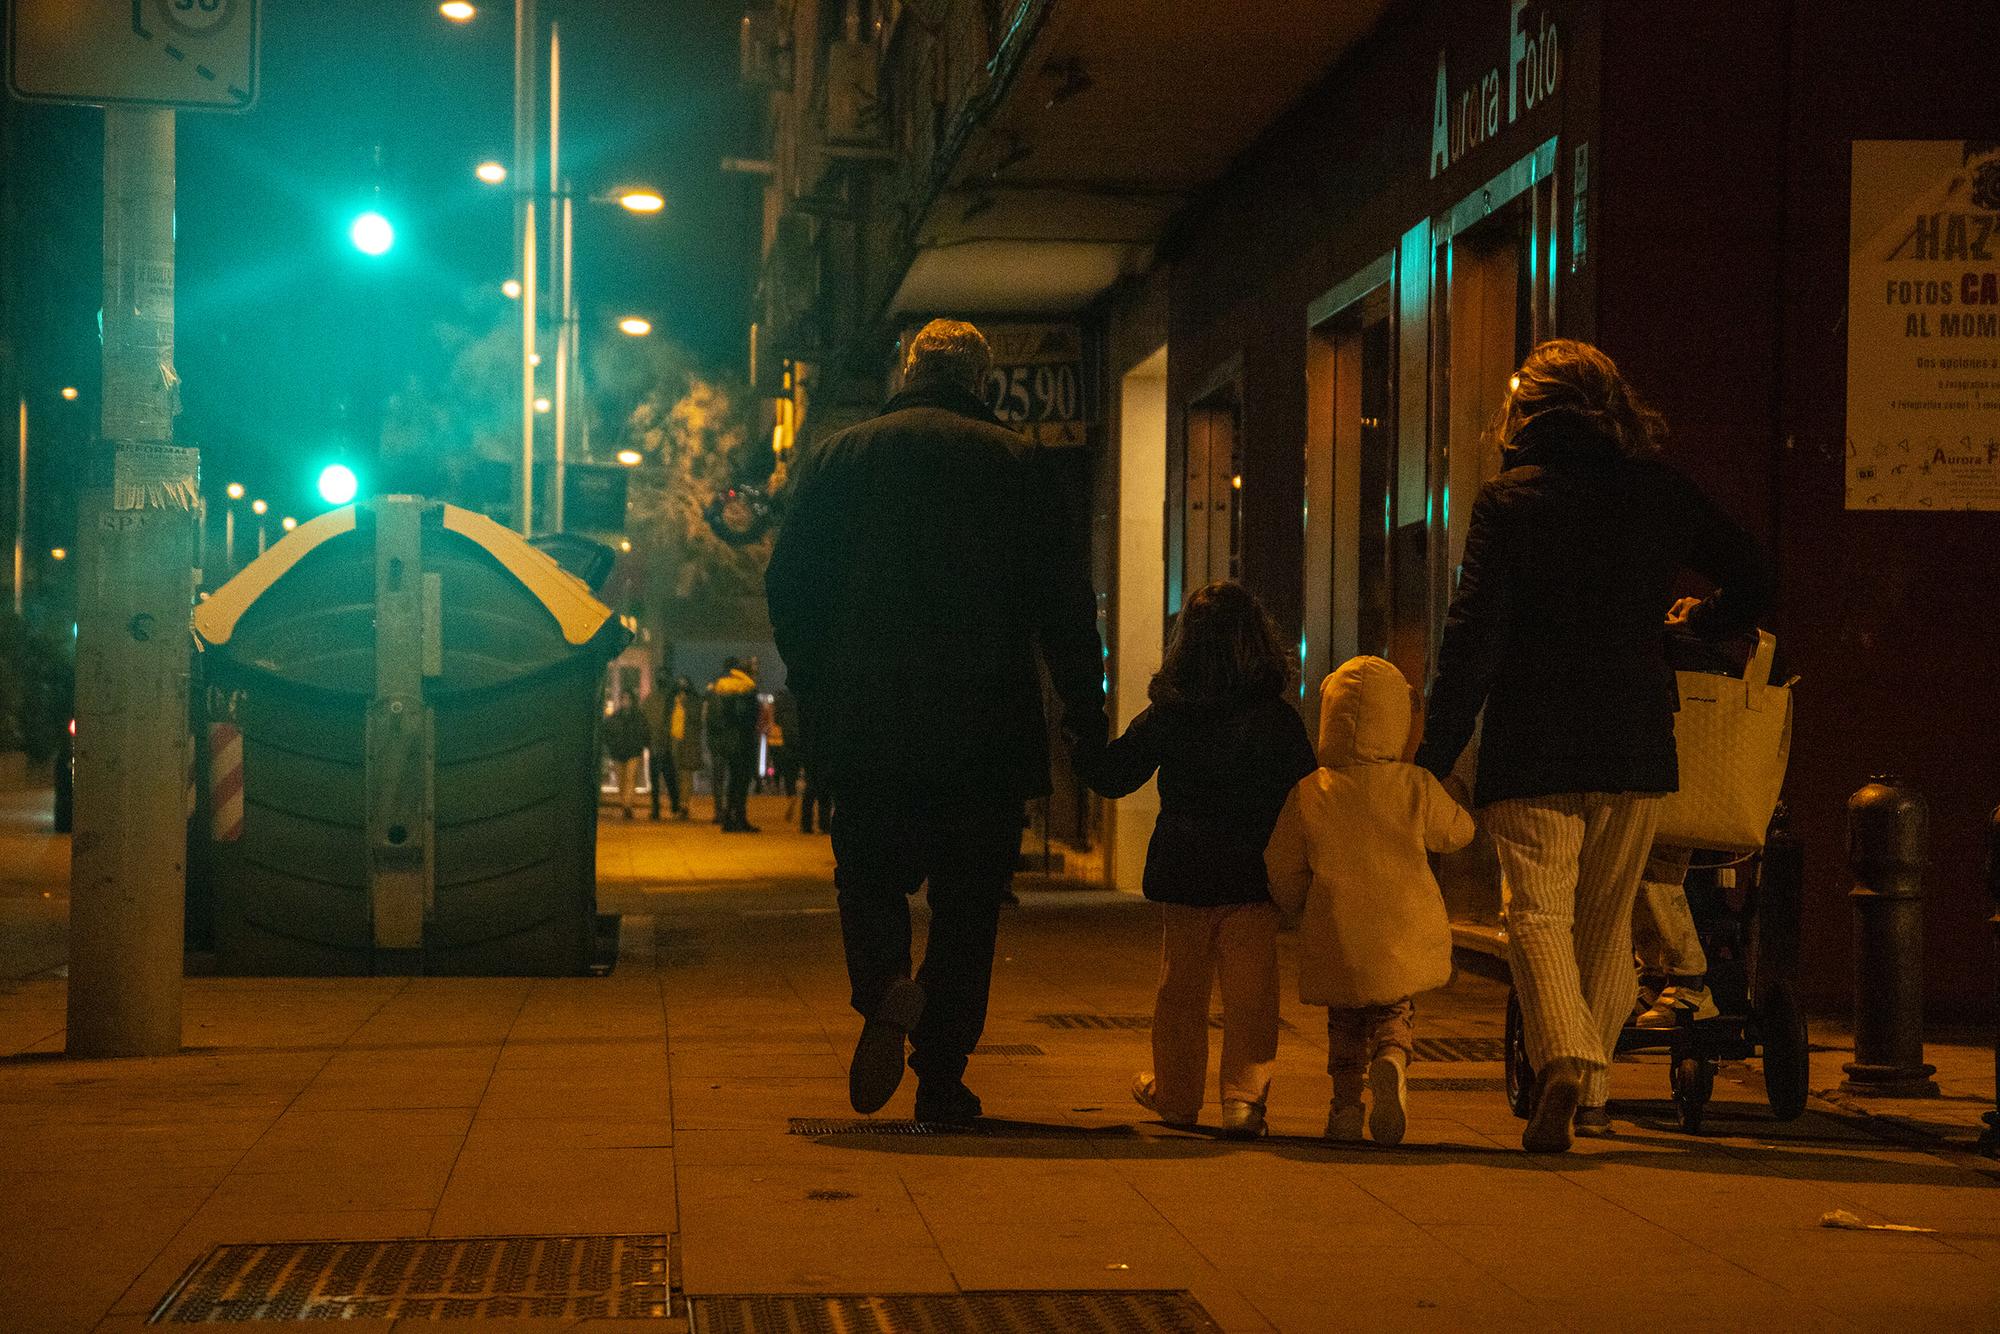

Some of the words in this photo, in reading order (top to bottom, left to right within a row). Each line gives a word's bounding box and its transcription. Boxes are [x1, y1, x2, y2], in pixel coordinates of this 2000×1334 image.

[1430, 48, 1499, 180] Aurora
[1508, 0, 1557, 124] Foto
[1886, 280, 1953, 305] FOTOS
[1905, 313, 1931, 337] AL
[114, 443, 187, 455] REFORMAS
[1932, 447, 1982, 465] Aurora
